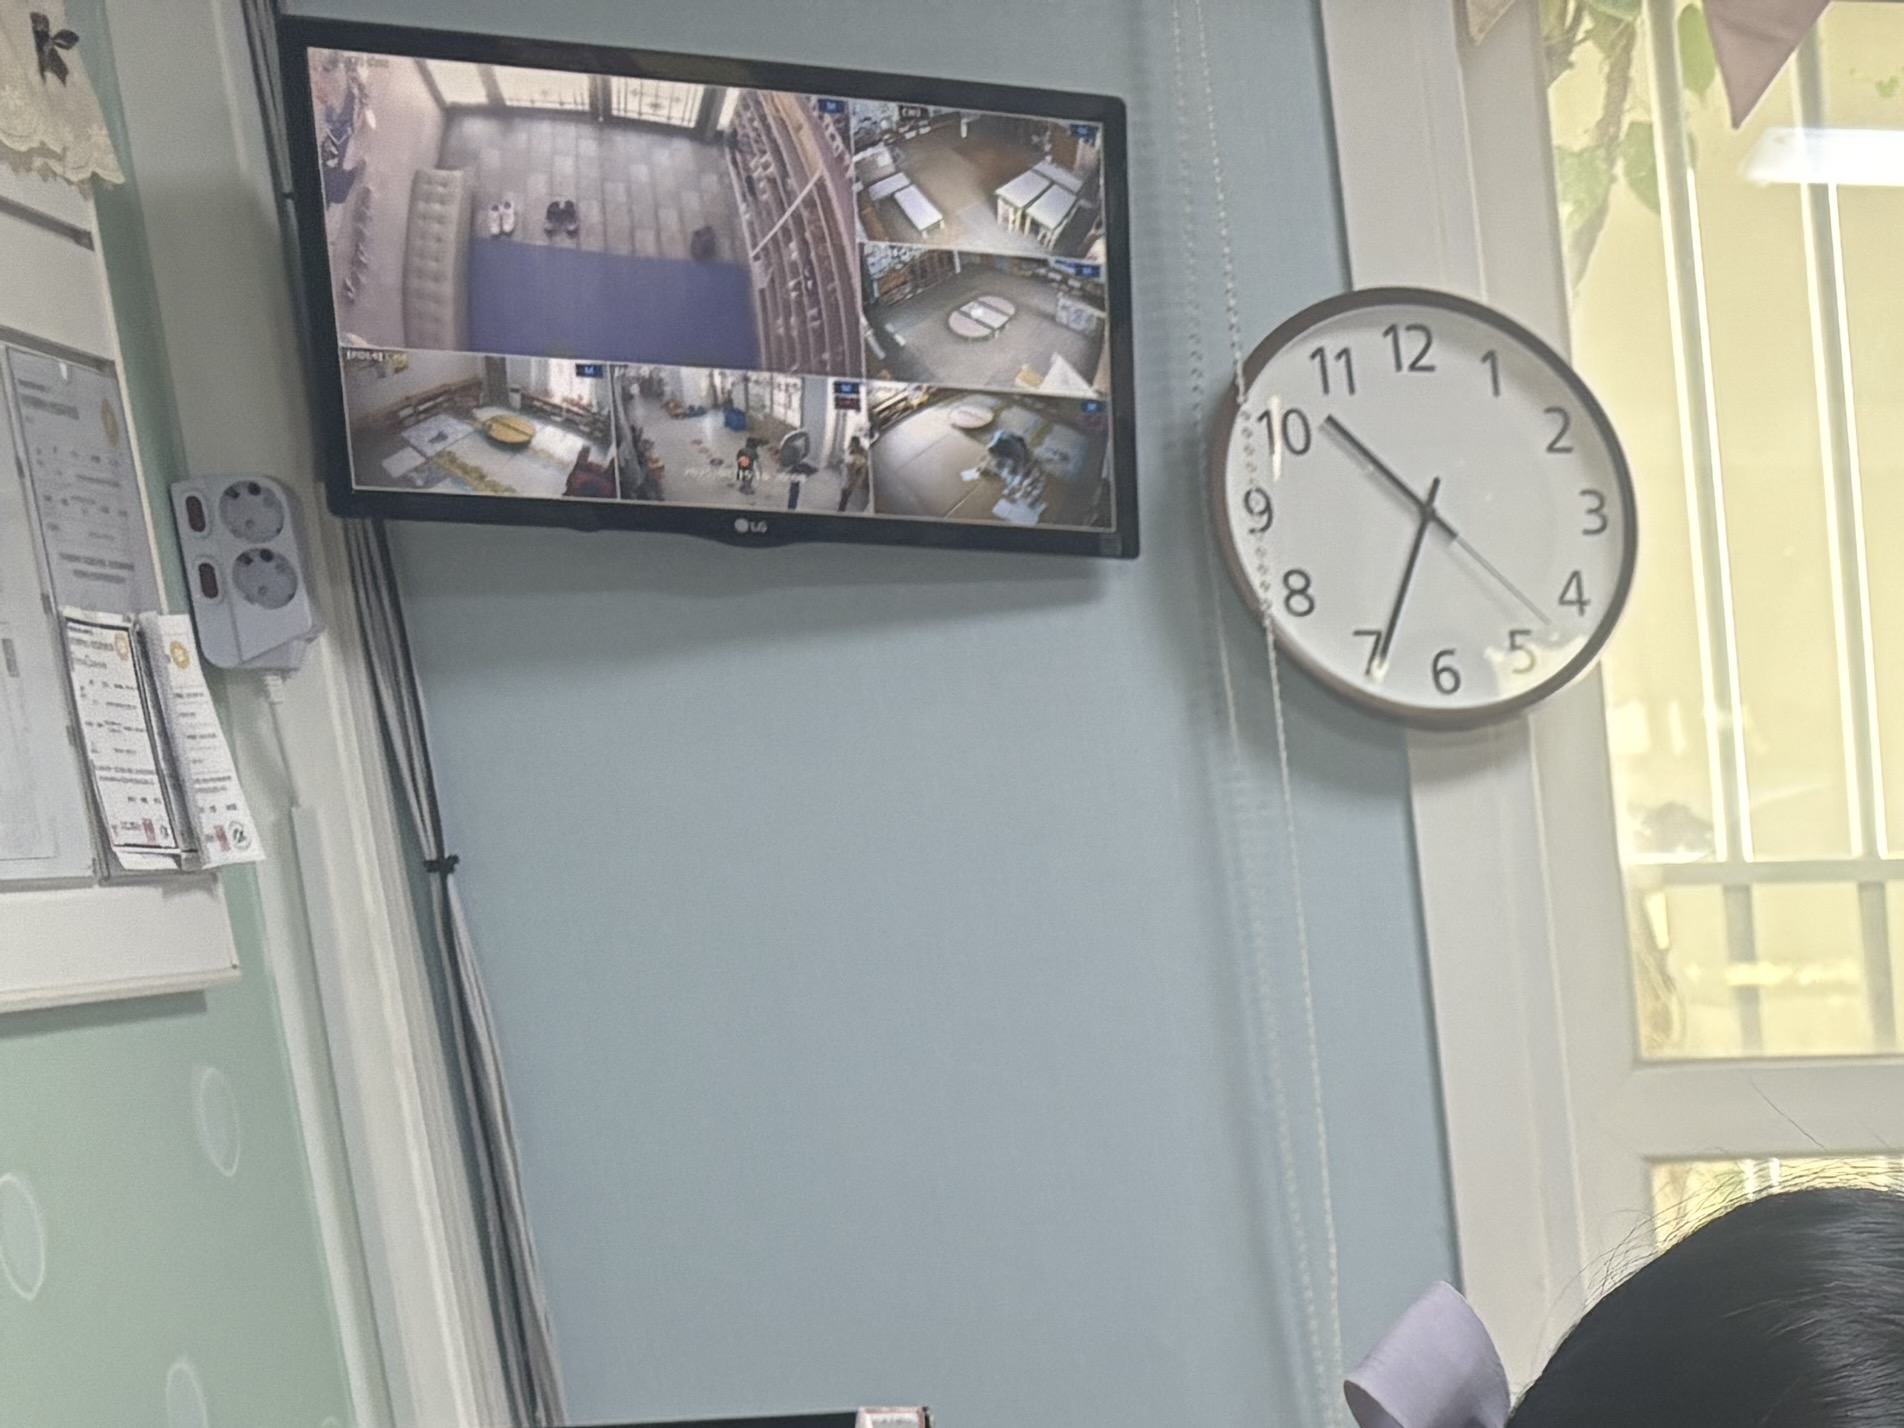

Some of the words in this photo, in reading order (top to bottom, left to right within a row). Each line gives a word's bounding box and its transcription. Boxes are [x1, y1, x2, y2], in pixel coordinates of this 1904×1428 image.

[1310, 347, 1356, 396] 11
[1382, 324, 1436, 373] 12
[1480, 351, 1500, 398] 1
[1257, 408, 1311, 456] 10
[1543, 406, 1574, 453] 2
[1243, 487, 1274, 534] 9
[1579, 489, 1609, 535] 3
[1282, 569, 1316, 617] 8
[1558, 570, 1591, 617] 4
[1353, 630, 1385, 677] 7
[1432, 649, 1461, 695] 6
[1508, 630, 1537, 674] 5
